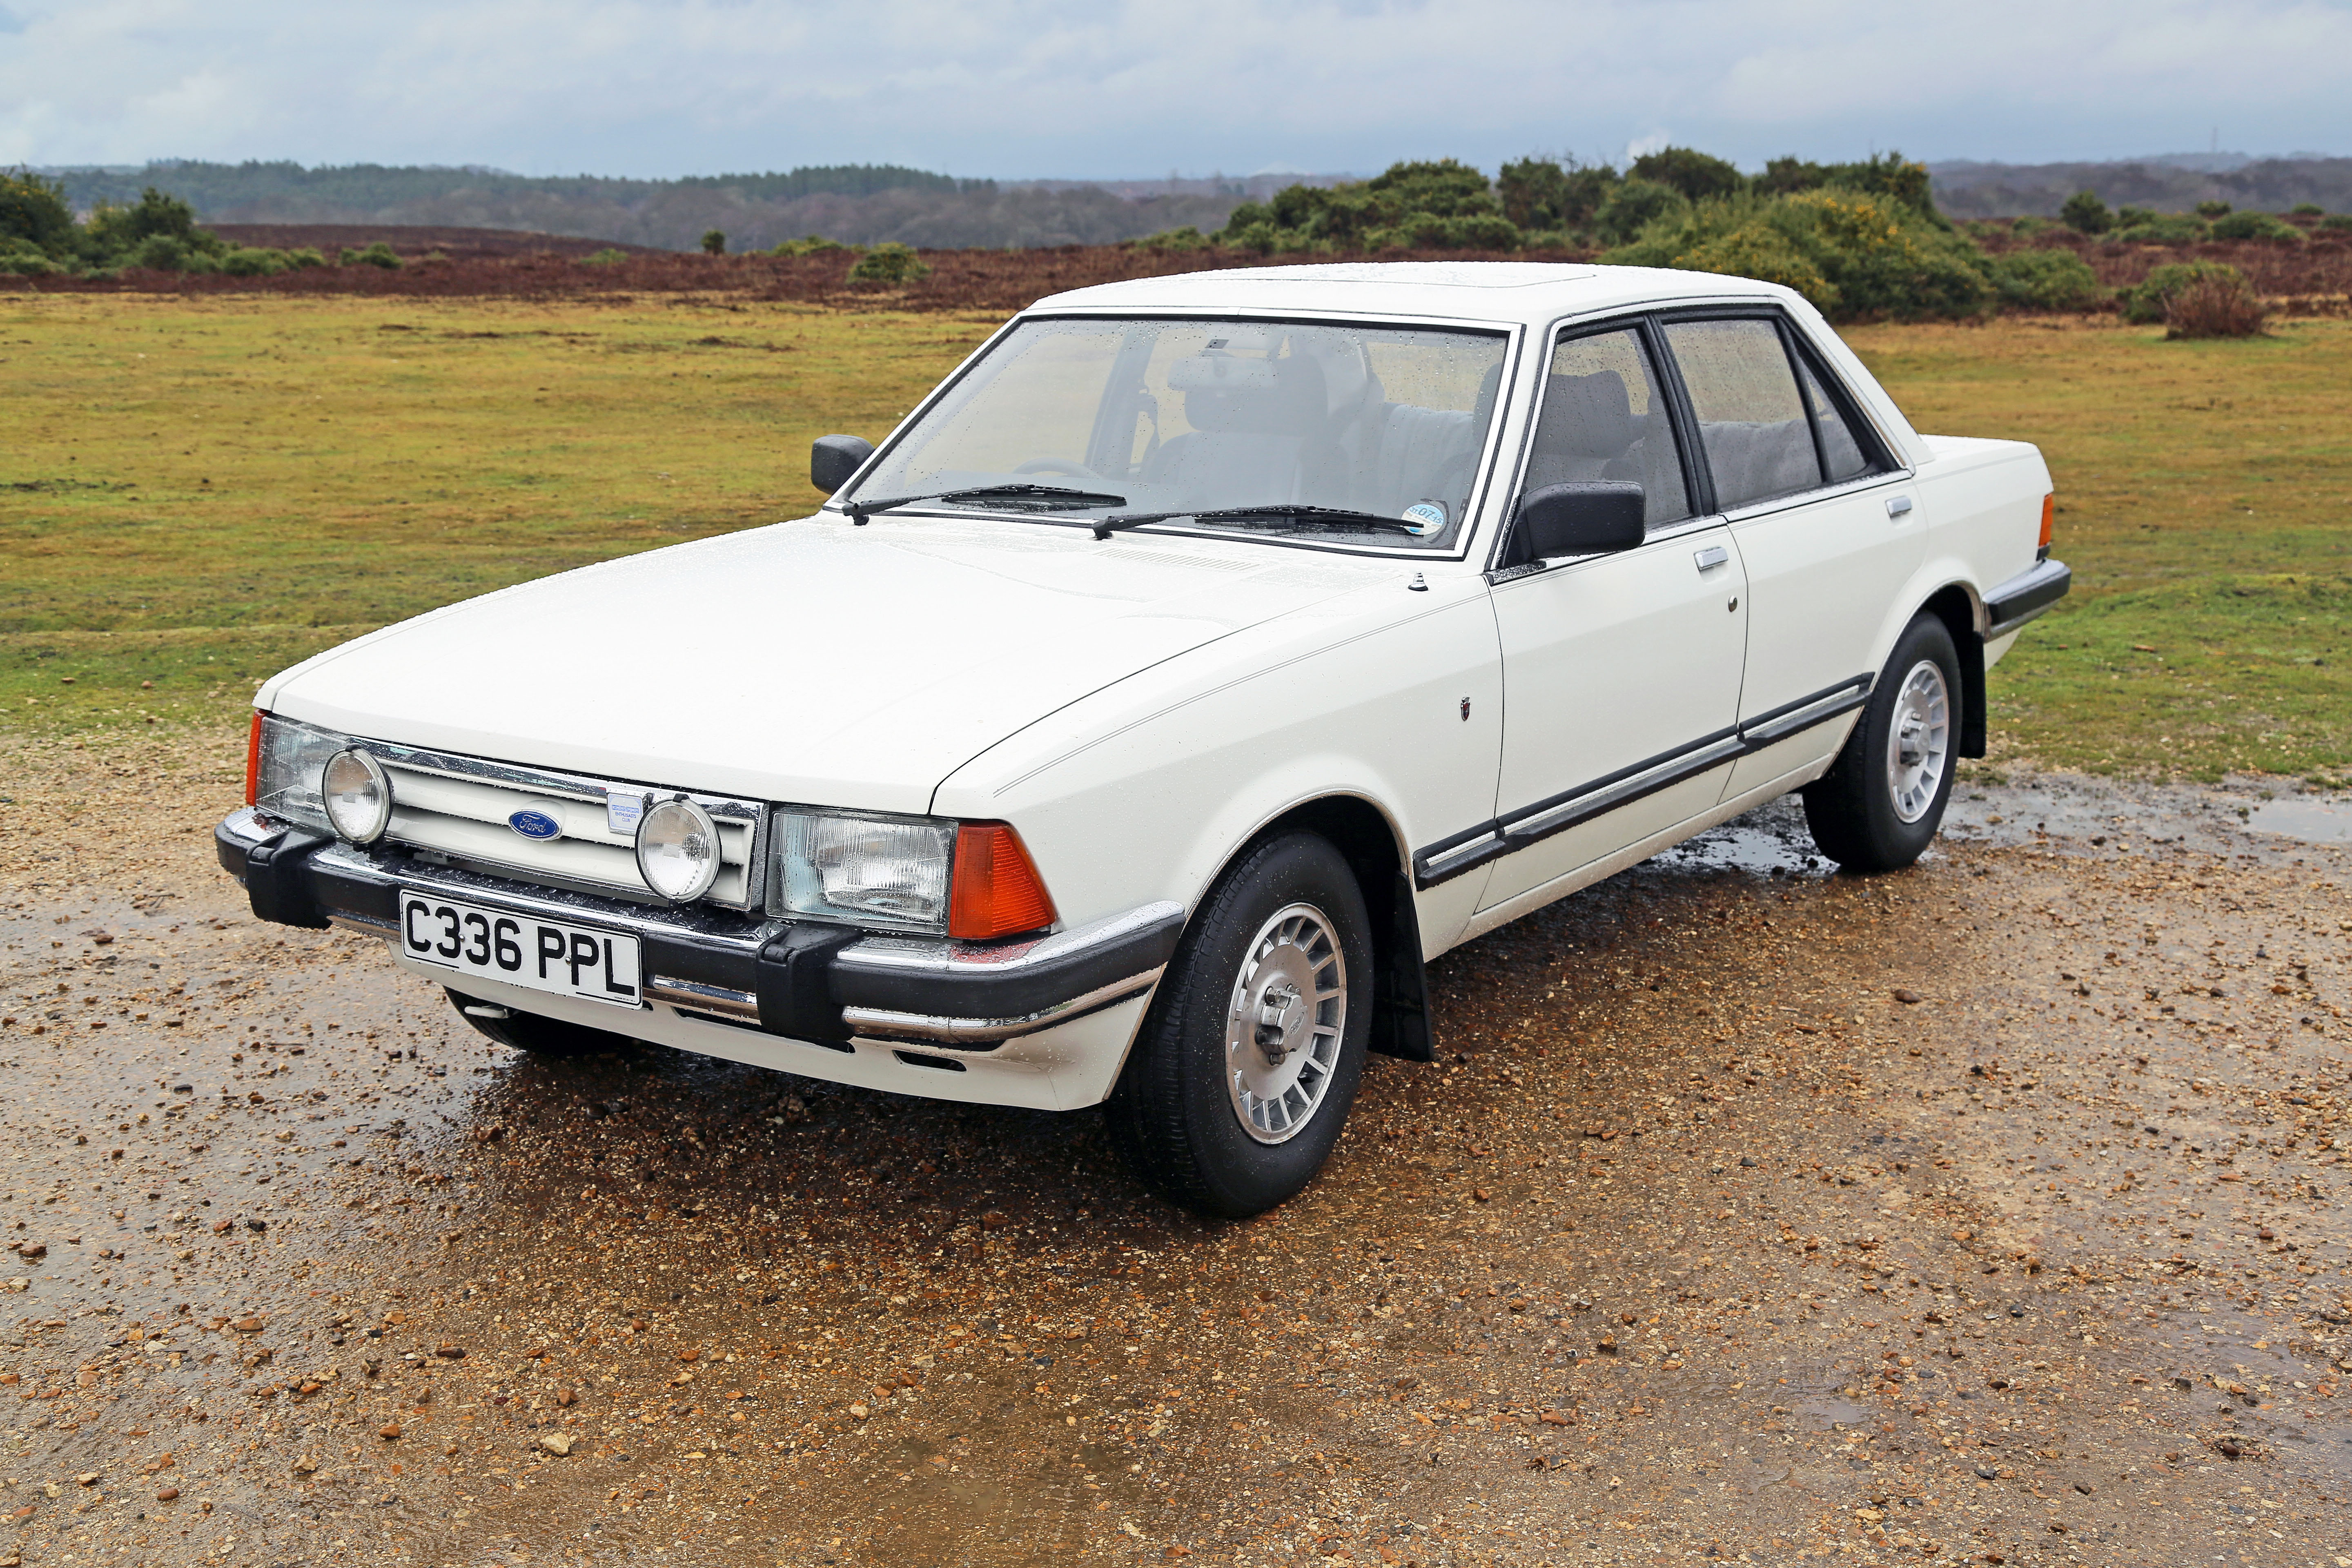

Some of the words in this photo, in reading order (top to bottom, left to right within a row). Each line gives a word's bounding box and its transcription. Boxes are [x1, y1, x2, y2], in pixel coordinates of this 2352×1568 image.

[1419, 508, 1435, 519] 07
[519, 814, 547, 833] Ford
[406, 900, 522, 972] C336
[537, 926, 635, 996] PPL
